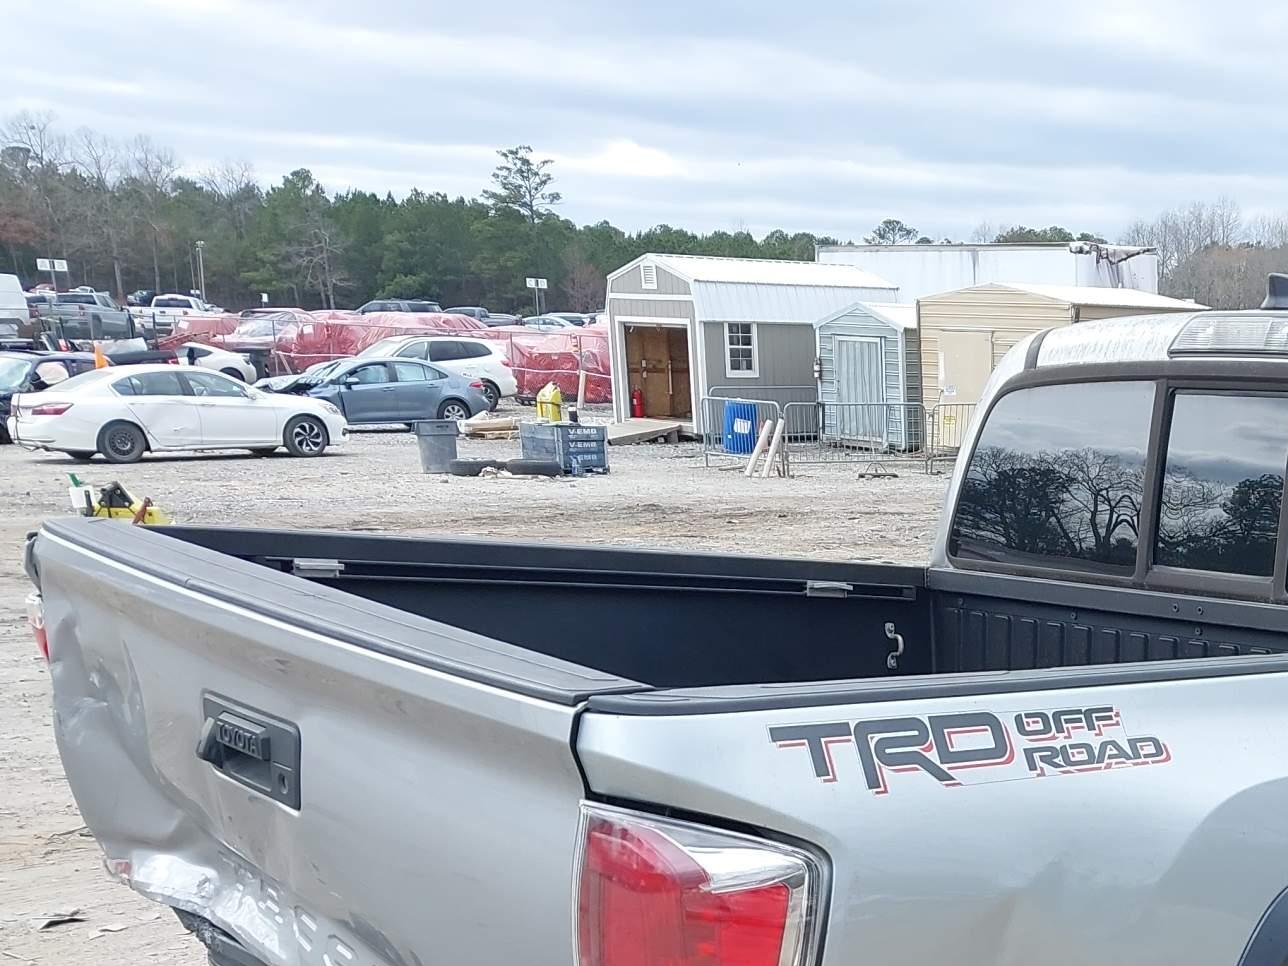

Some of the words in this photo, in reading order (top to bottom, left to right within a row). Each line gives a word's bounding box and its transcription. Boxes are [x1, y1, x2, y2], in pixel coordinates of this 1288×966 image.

[216, 720, 262, 759] TOYOTA
[769, 711, 1016, 795] TRD
[1014, 704, 1121, 741] OFF
[1023, 734, 1172, 778] ROAD
